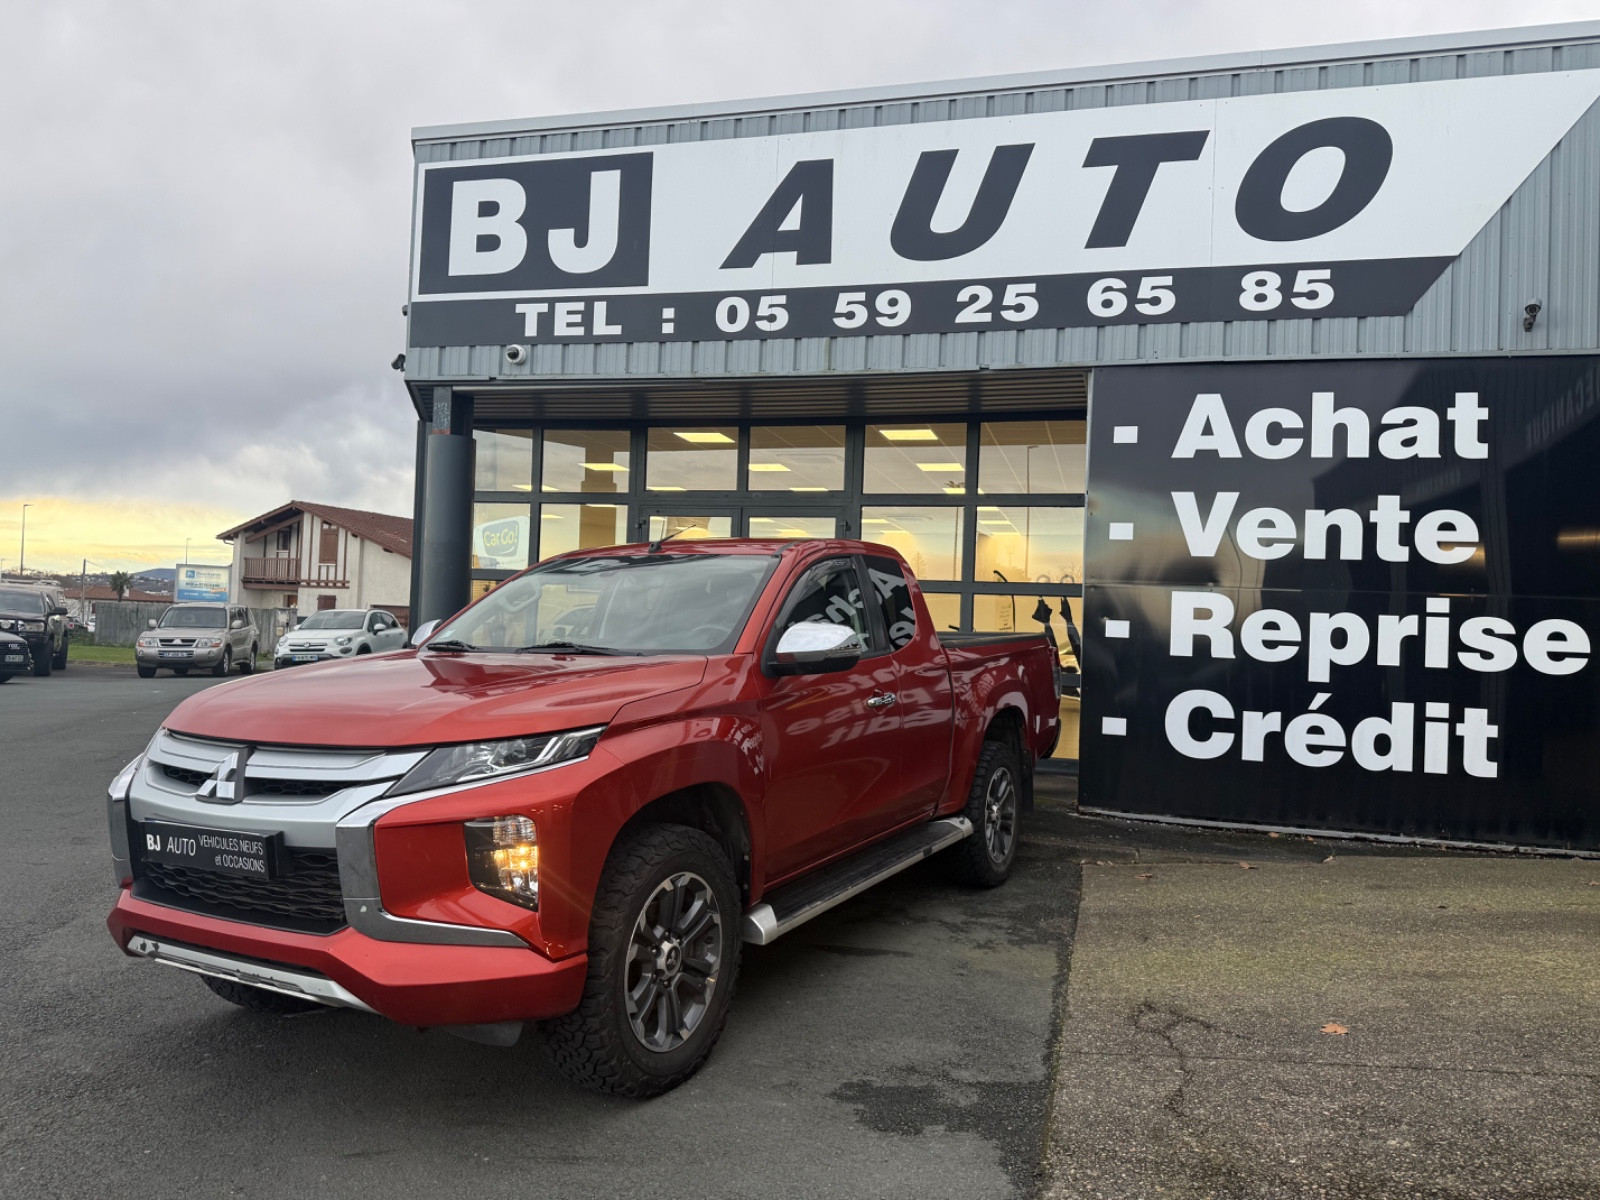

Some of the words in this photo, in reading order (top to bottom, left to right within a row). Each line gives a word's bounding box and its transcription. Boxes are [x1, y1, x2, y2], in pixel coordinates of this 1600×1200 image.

[448, 169, 621, 277] BJ
[719, 116, 1393, 269] AUTO
[515, 301, 622, 337] TEL
[715, 296, 790, 333] 05
[833, 290, 912, 329] 59
[955, 283, 1040, 324] 25
[1087, 275, 1176, 318] 65
[1239, 269, 1334, 312] 85
[1171, 392, 1489, 460] Achat
[1170, 491, 1479, 564] Vente
[1169, 590, 1591, 683] Reprise
[1165, 689, 1498, 778] Crédit
[146, 834, 161, 851] BJ
[166, 836, 196, 856] AUTO
[198, 834, 238, 851] VEHICULES
[240, 839, 263, 856] NEUFS
[215, 854, 222, 867] et
[223, 854, 265, 873] OCCASIONS
